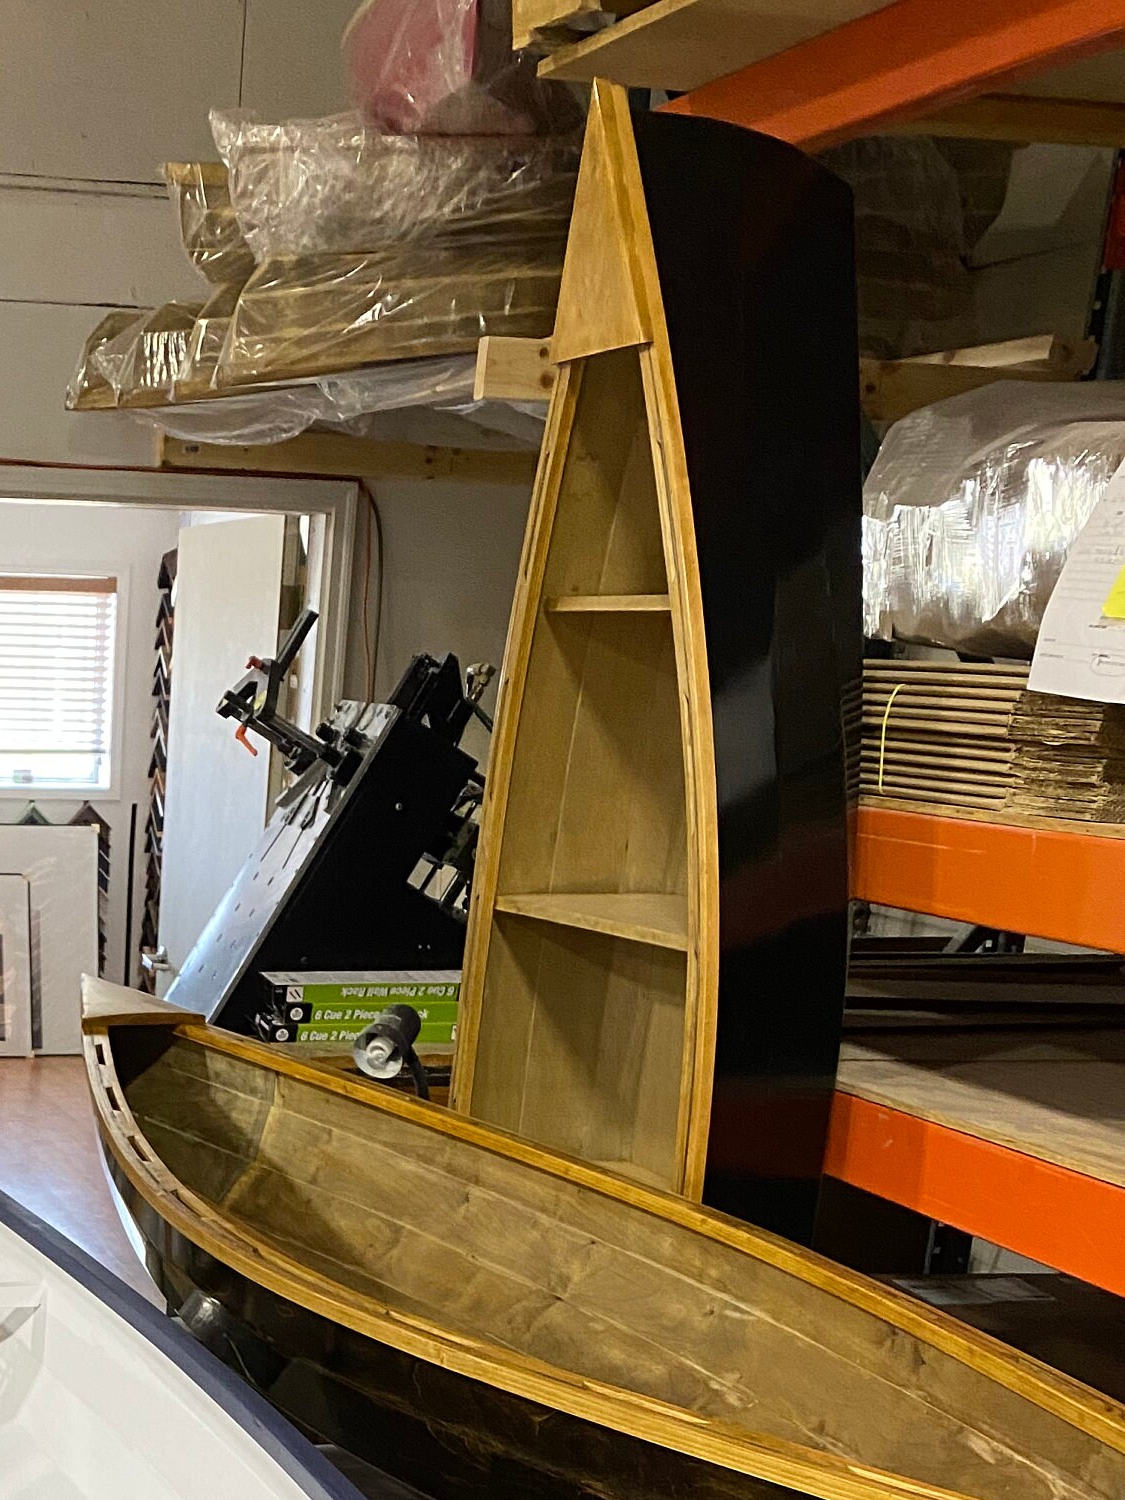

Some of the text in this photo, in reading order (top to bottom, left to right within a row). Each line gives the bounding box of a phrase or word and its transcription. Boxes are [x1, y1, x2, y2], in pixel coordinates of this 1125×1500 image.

[341, 986, 365, 997] Rack
[389, 986, 417, 997] Piece
[418, 986, 426, 996] 2
[427, 986, 446, 997] Cue
[324, 1009, 343, 1020] Cue
[344, 1009, 352, 1020] 2
[310, 1030, 329, 1041] Cue
[330, 1030, 338, 1041] 2
